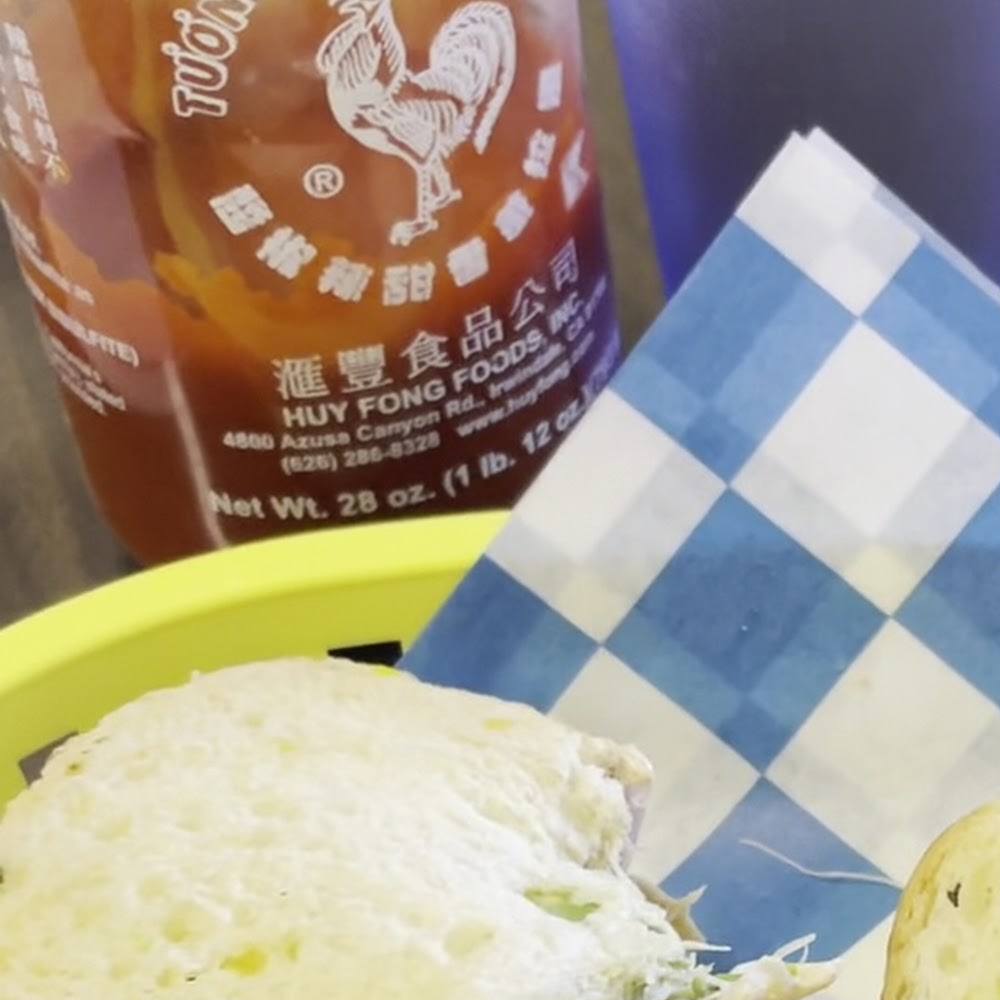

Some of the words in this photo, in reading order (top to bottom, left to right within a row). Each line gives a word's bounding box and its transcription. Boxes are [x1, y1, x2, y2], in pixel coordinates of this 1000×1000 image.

[282, 401, 348, 428] HUY
[357, 378, 447, 420] FONG
[281, 432, 350, 450] Azusa
[356, 410, 441, 441] Canyon
[209, 489, 266, 519] Net
[270, 496, 330, 519] Wt.
[337, 489, 378, 517] 28
[388, 483, 436, 508] oz.
[480, 453, 516, 479] lb.
[522, 420, 551, 454] 12
[281, 452, 338, 476] (626)
